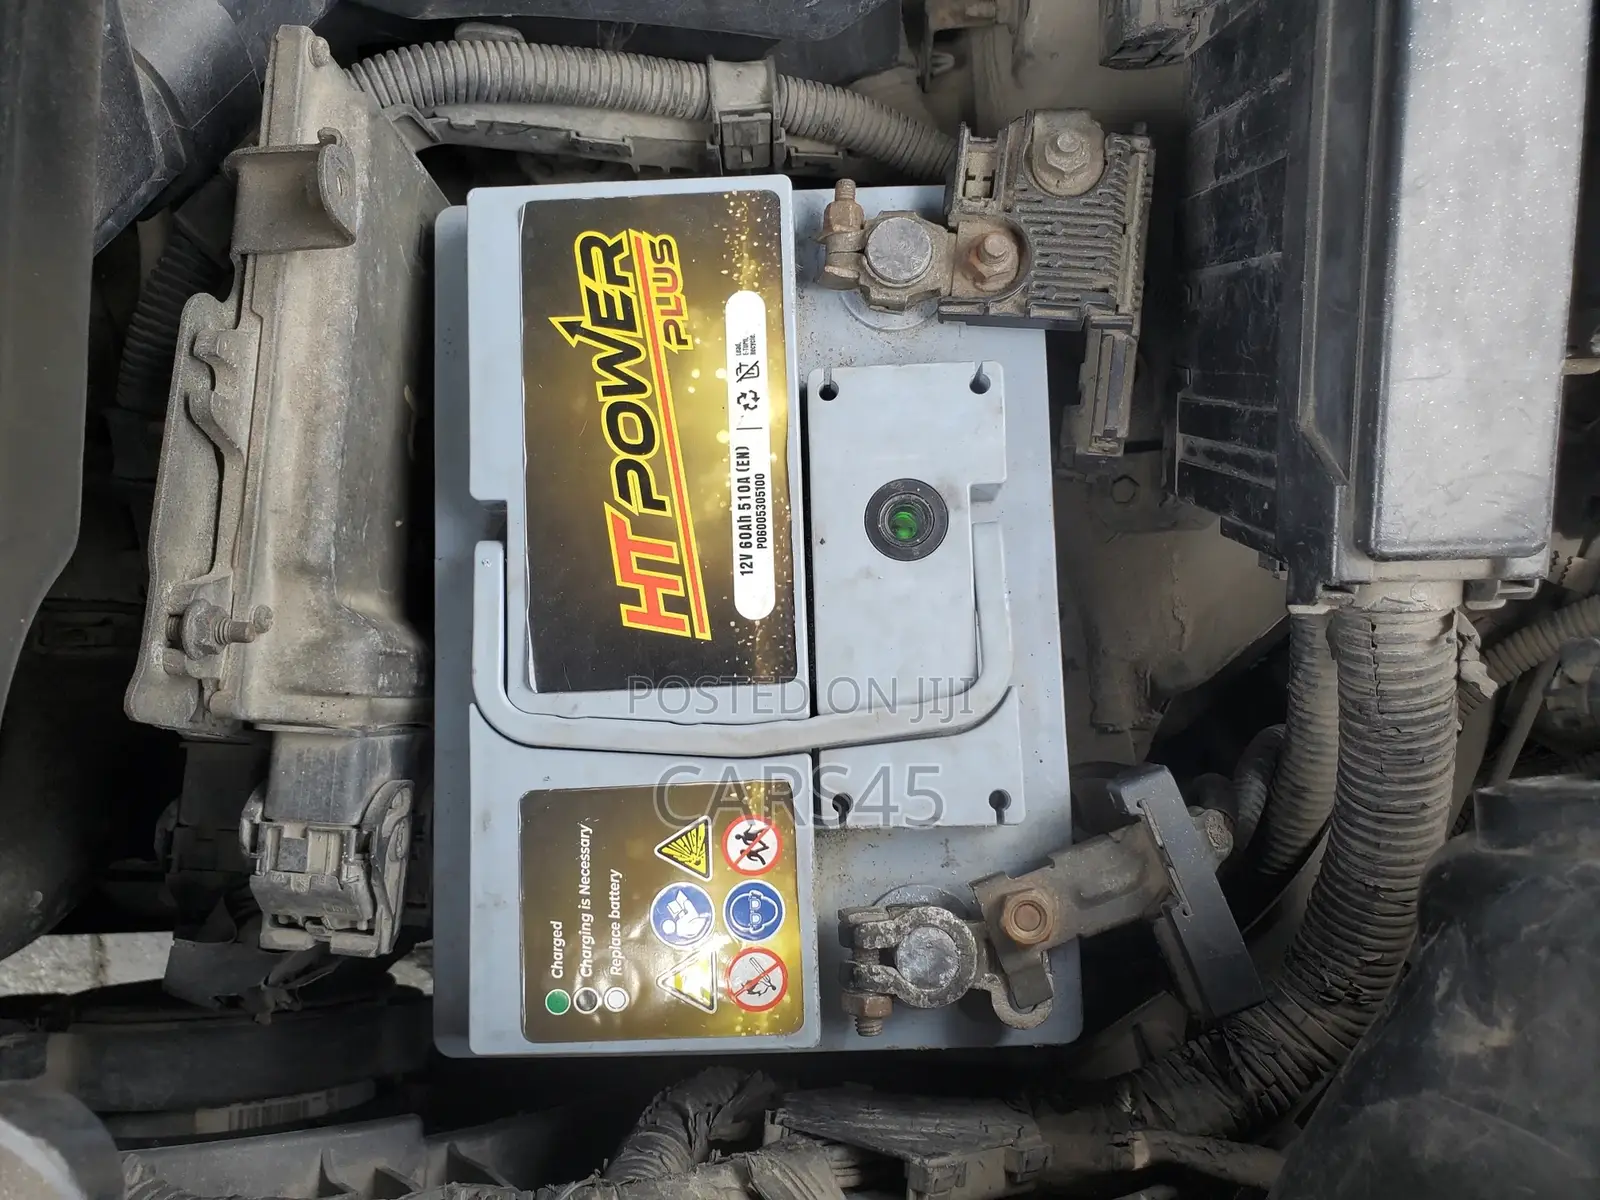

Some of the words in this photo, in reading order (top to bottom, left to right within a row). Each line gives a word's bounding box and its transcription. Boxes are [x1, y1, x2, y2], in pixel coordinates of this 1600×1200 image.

[643, 231, 694, 354] PLUS
[548, 231, 672, 517] POWER
[735, 446, 750, 473] (EN)
[737, 476, 752, 511] 510A
[754, 473, 768, 549] P06005305100
[737, 515, 753, 549] 60Ah
[604, 501, 692, 638] HT
[739, 553, 754, 577] 12V
[578, 824, 593, 895] Necessary
[577, 898, 591, 910] is
[607, 868, 623, 919] battery
[550, 920, 566, 979] Charged
[578, 912, 596, 978] Charging
[608, 920, 625, 976] Replace
